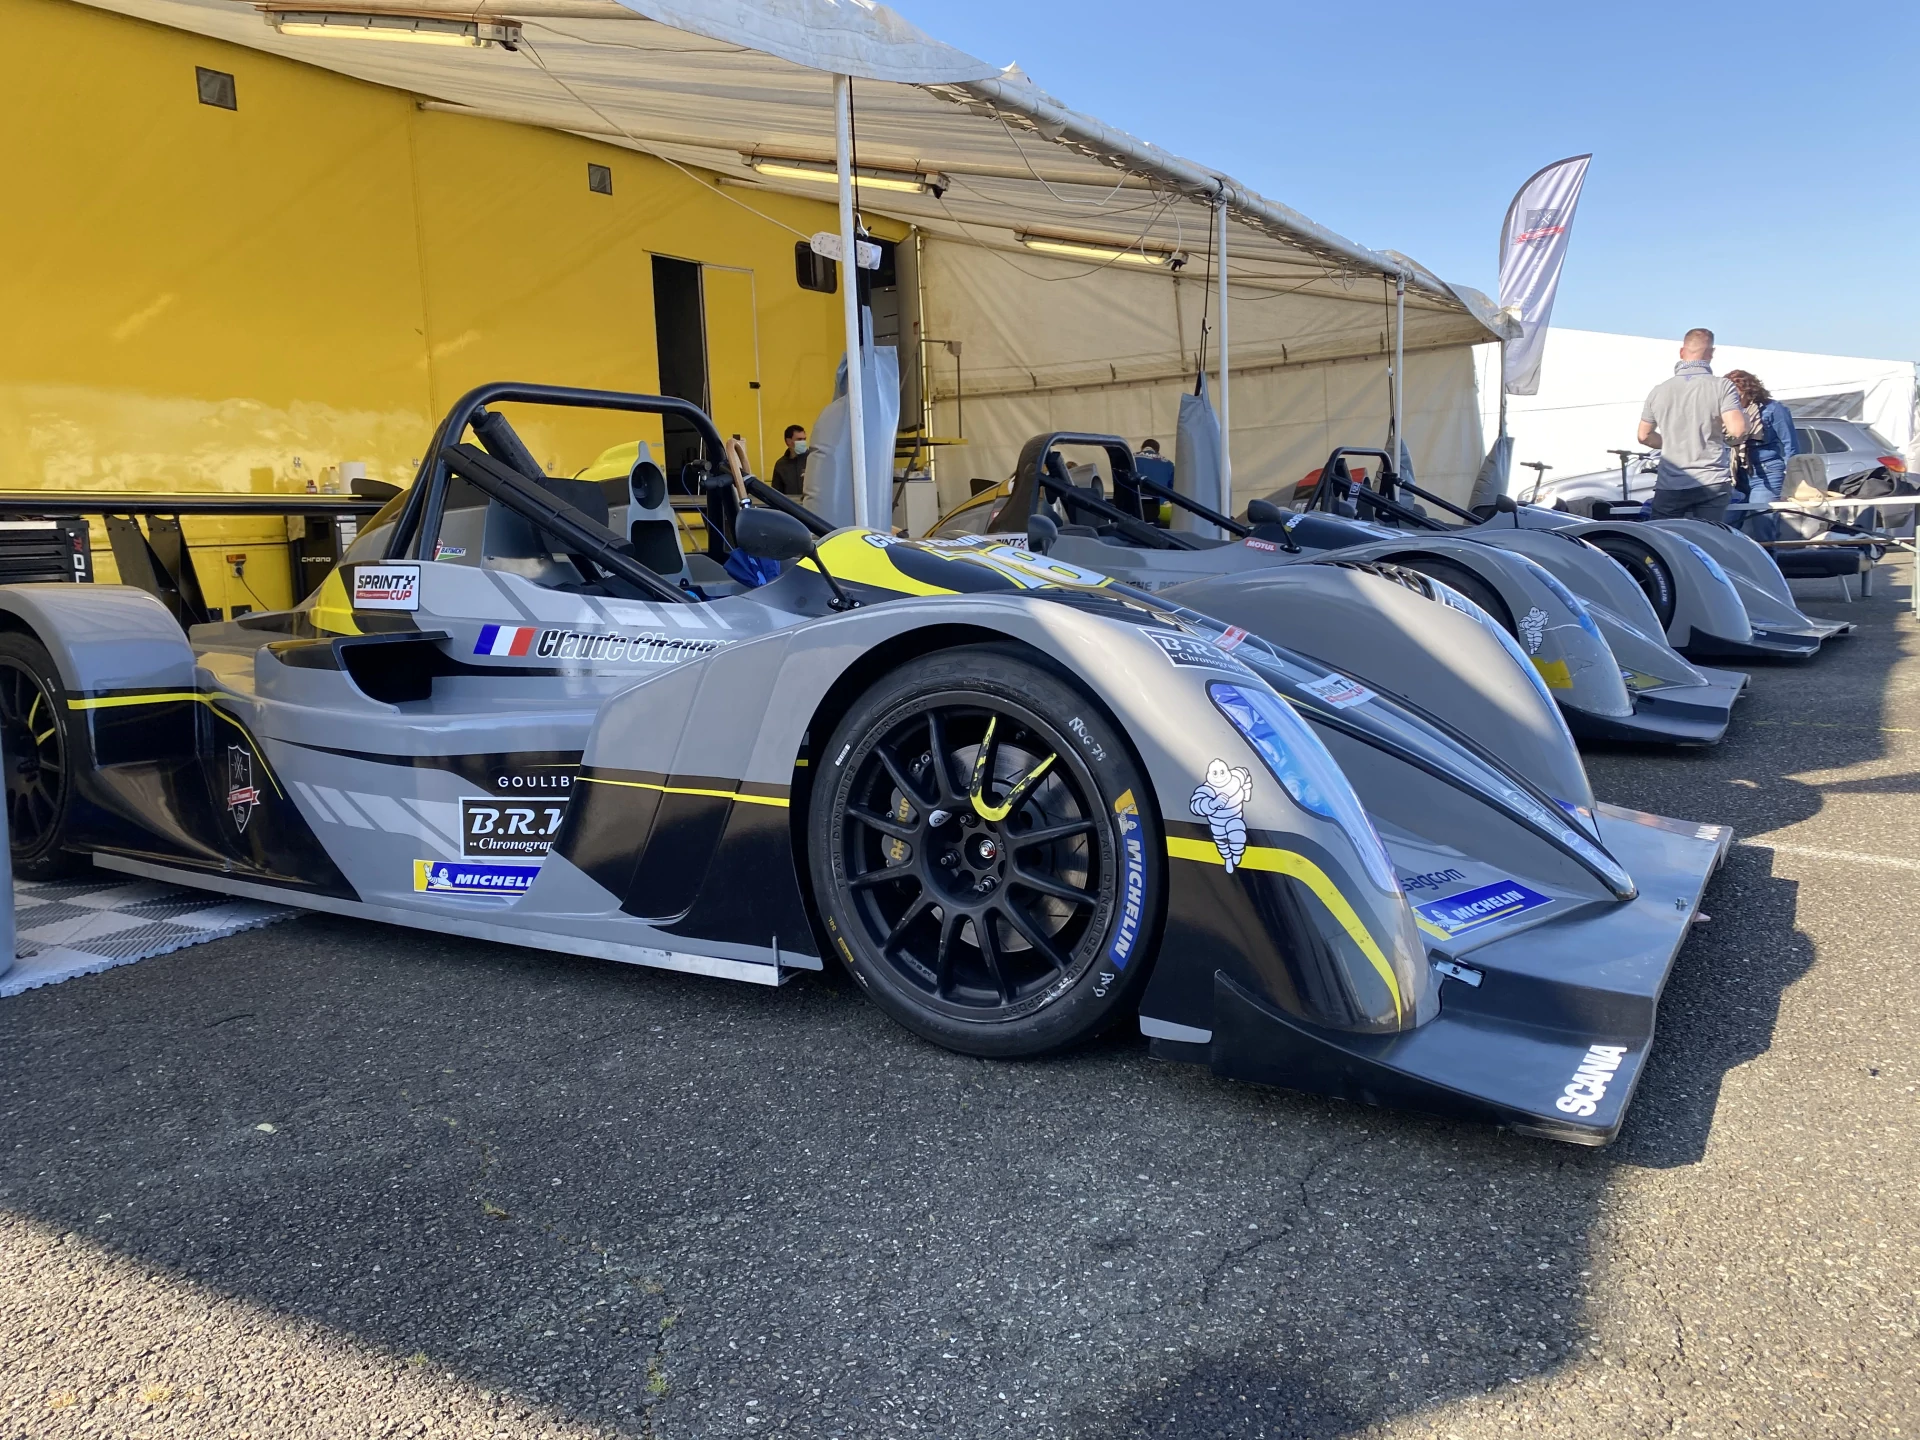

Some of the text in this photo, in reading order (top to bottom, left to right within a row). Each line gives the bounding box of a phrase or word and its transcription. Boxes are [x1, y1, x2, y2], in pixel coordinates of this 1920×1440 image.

[1246, 540, 1275, 551] MOTUL
[389, 590, 412, 601] CUP
[536, 628, 738, 663] Claude Chau
[857, 700, 928, 757] MOTORSPORT
[498, 776, 576, 787] GOULIB
[833, 765, 856, 840] DYNAMICS
[833, 851, 846, 889] TEAM
[1114, 838, 1144, 960] MICHELIN
[1451, 890, 1526, 920] MICHELIN
[1556, 1045, 1628, 1117] SCANIA
